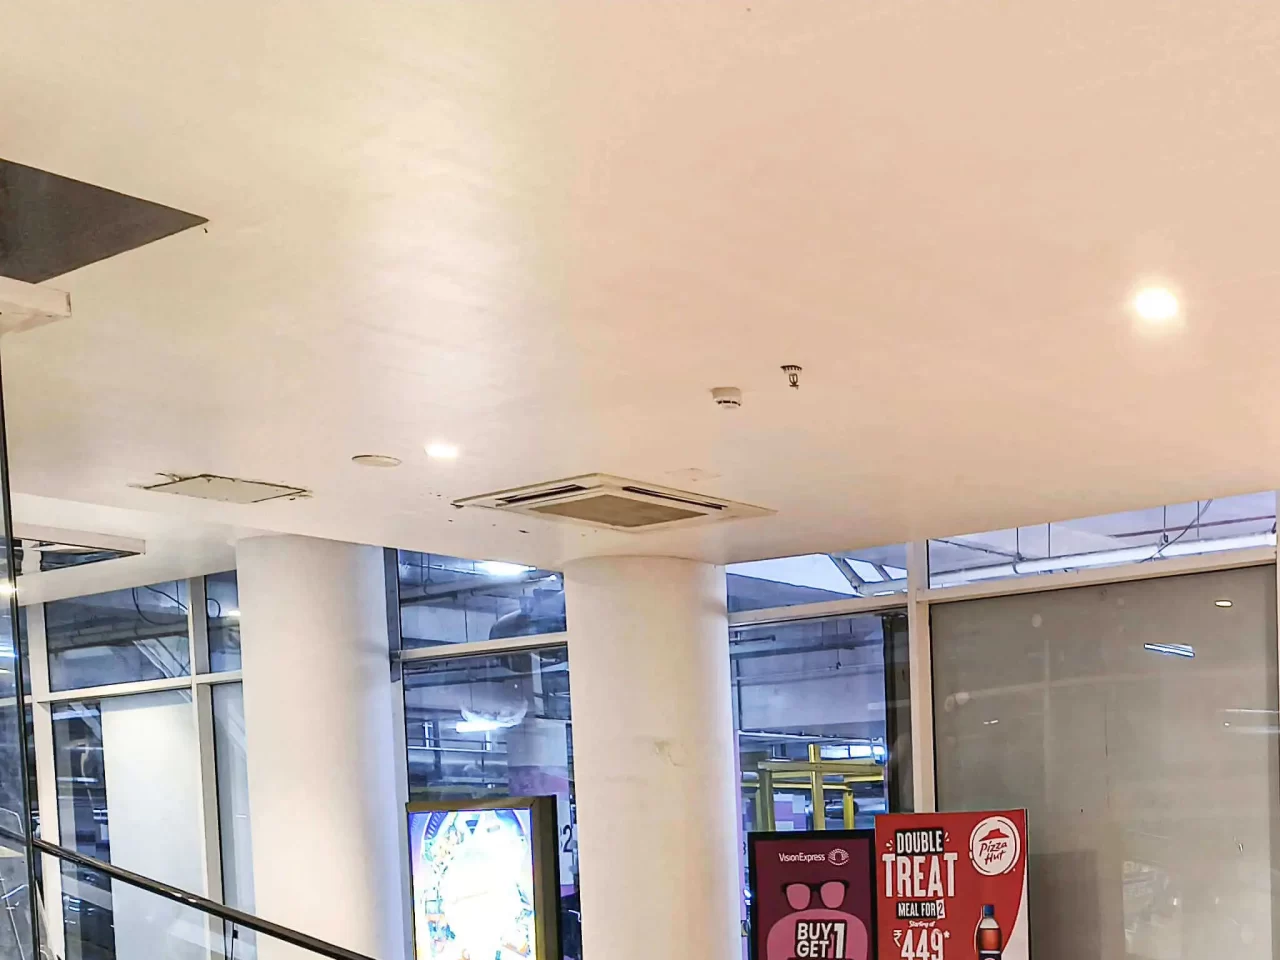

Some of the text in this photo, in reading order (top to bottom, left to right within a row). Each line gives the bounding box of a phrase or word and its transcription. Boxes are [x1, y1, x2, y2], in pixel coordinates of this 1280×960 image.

[897, 830, 944, 854] DOUBLE
[979, 841, 1007, 857] Pizza
[779, 852, 826, 863] VisionExpress
[985, 850, 1006, 866] Hut
[882, 852, 958, 898] TREAT
[899, 902, 944, 917] MEAL FOR 2
[797, 922, 845, 958] BUY 1
[796, 940, 829, 958] GET
